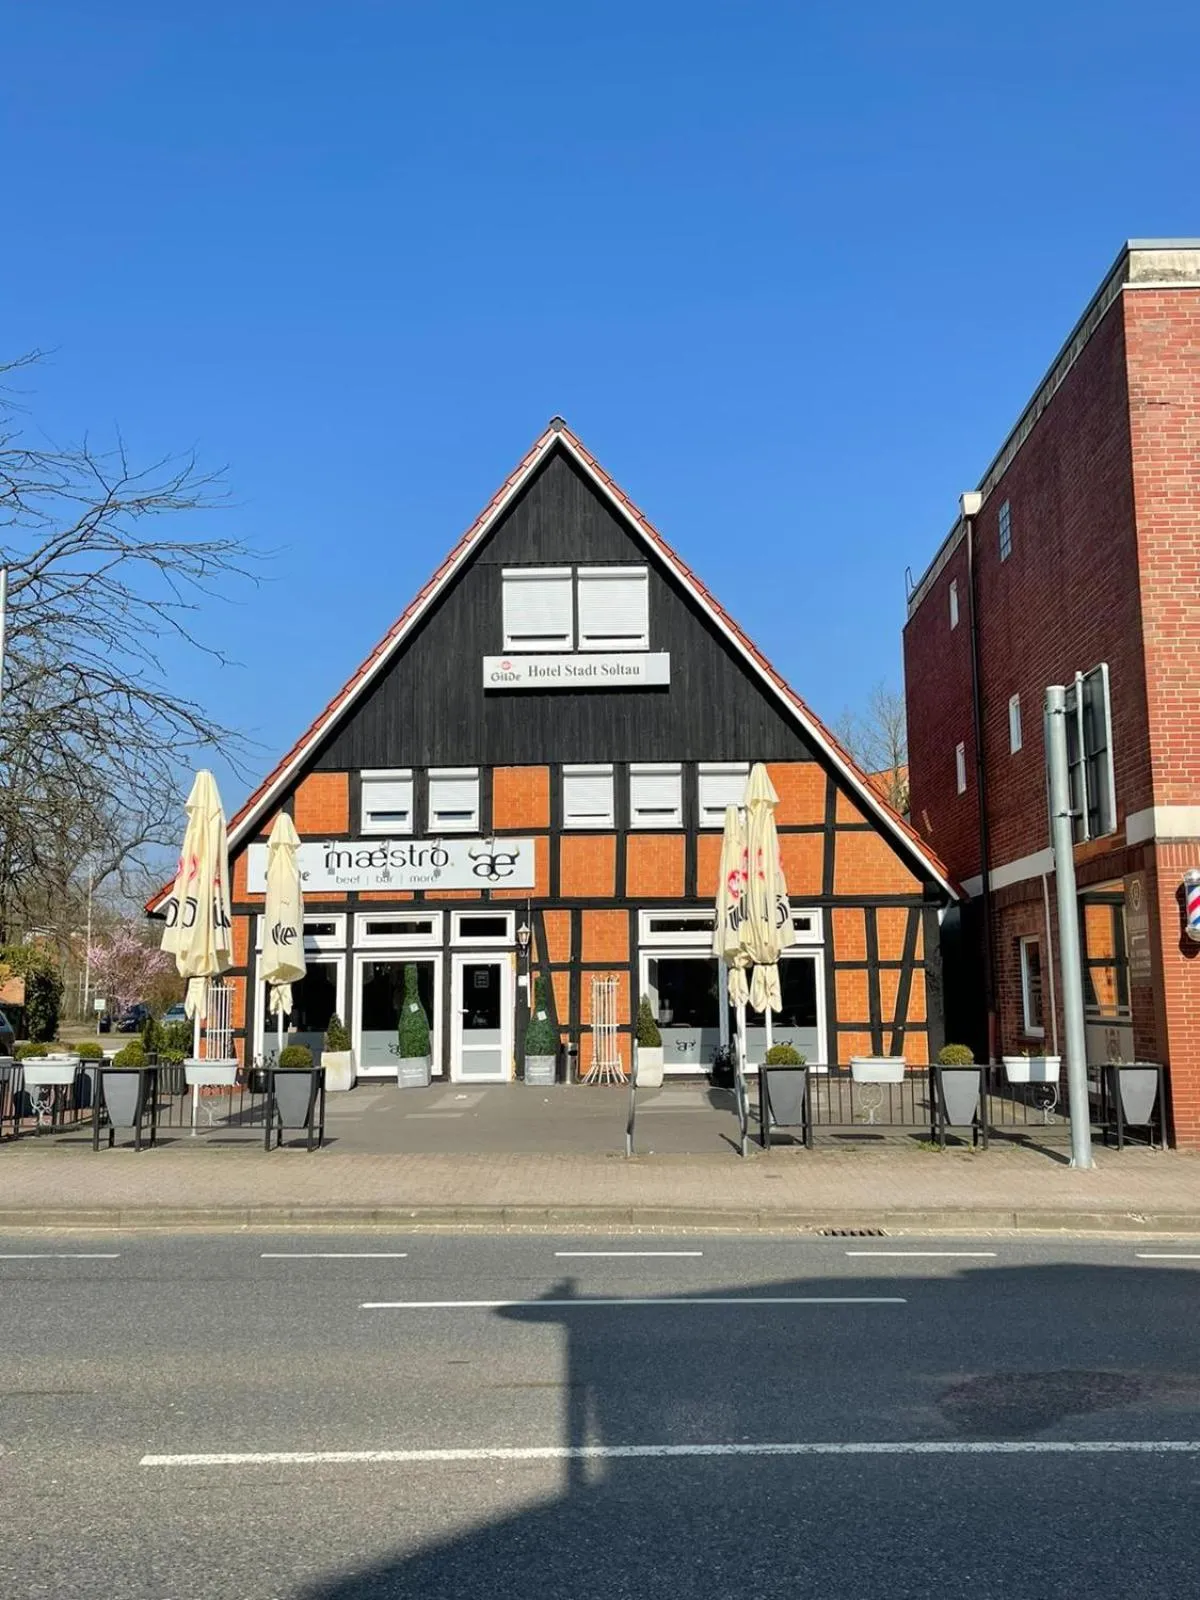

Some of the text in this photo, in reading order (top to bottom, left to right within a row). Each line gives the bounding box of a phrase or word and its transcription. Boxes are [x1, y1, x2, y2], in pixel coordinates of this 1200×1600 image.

[528, 663, 641, 678] Hotel Stadt Soltau
[335, 874, 439, 884] beef bar more
